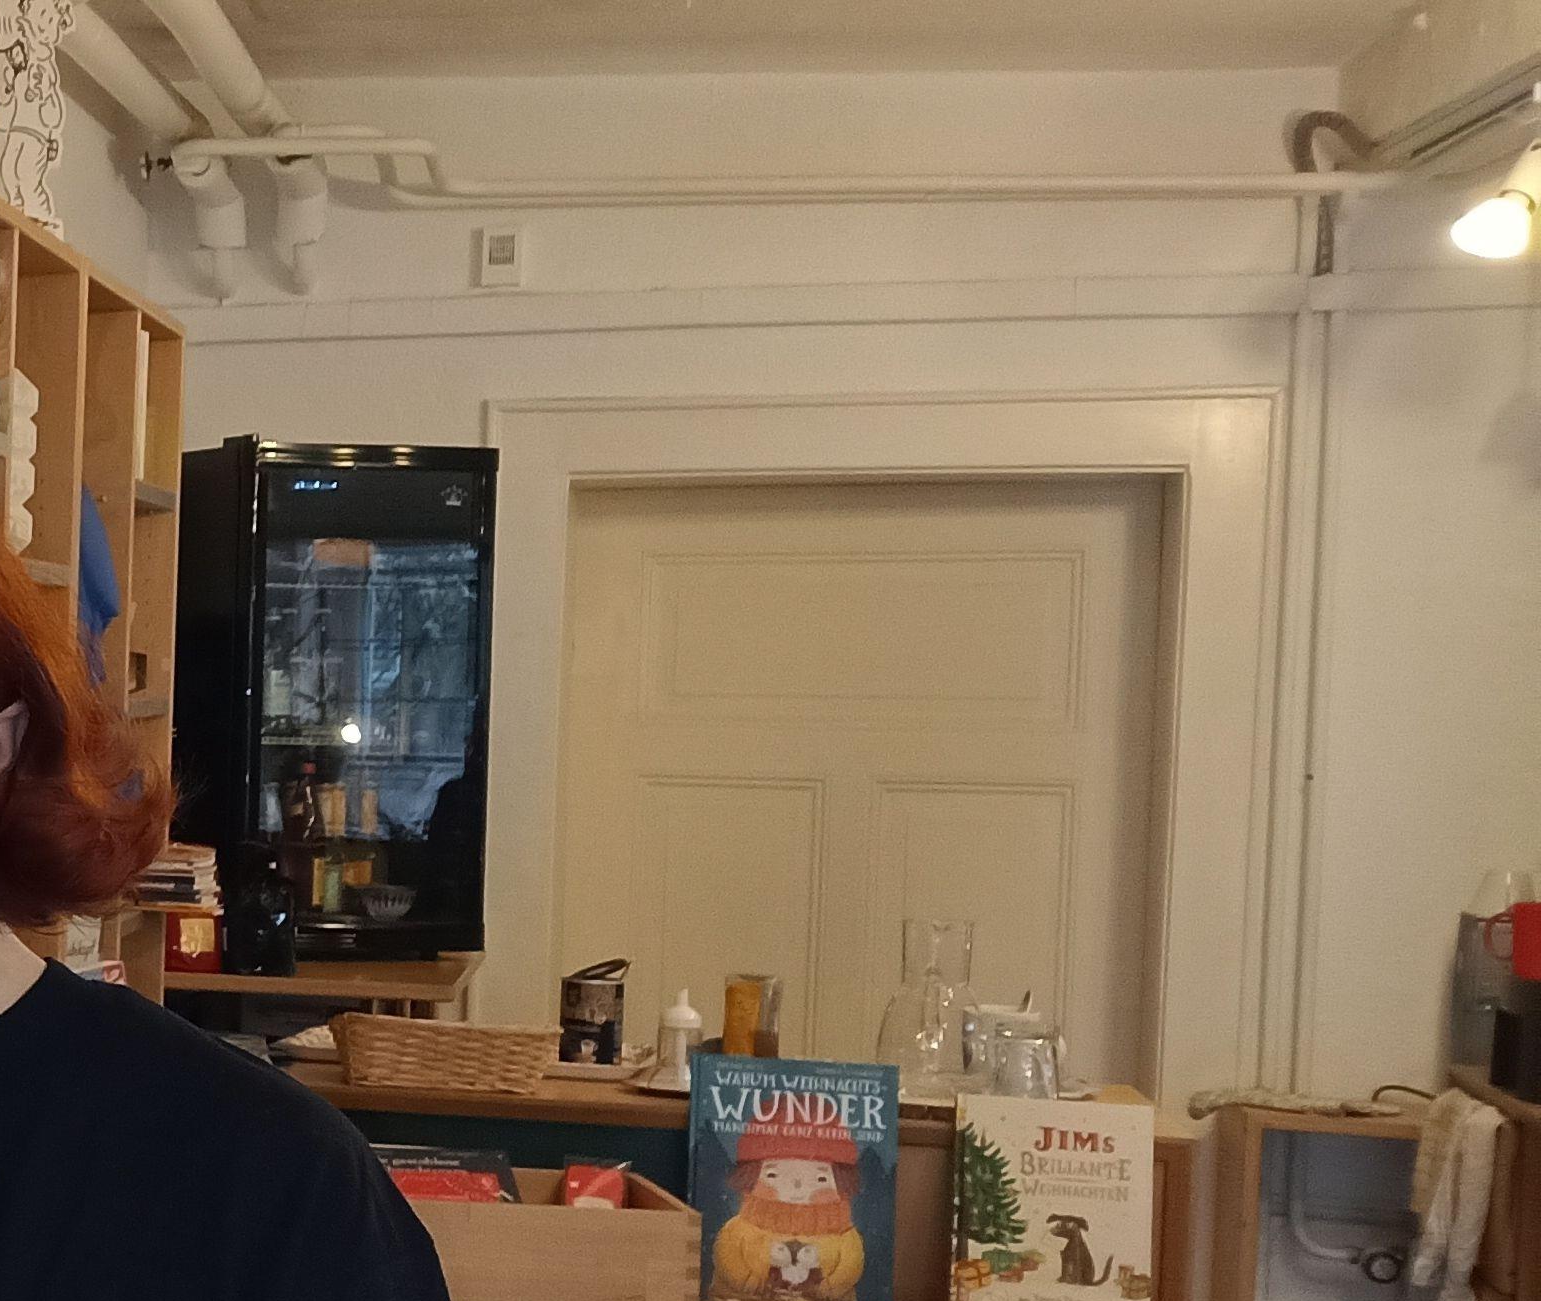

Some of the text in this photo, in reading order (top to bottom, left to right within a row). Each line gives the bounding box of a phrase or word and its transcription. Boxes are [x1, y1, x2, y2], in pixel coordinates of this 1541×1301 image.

[715, 1069, 888, 1096] WARUM WEIHNACHTS-
[710, 1085, 888, 1131] WUNDER
[1019, 1150, 1133, 1183] BRILLANTE
[1021, 1177, 1131, 1202] WEIHNACHTEN
